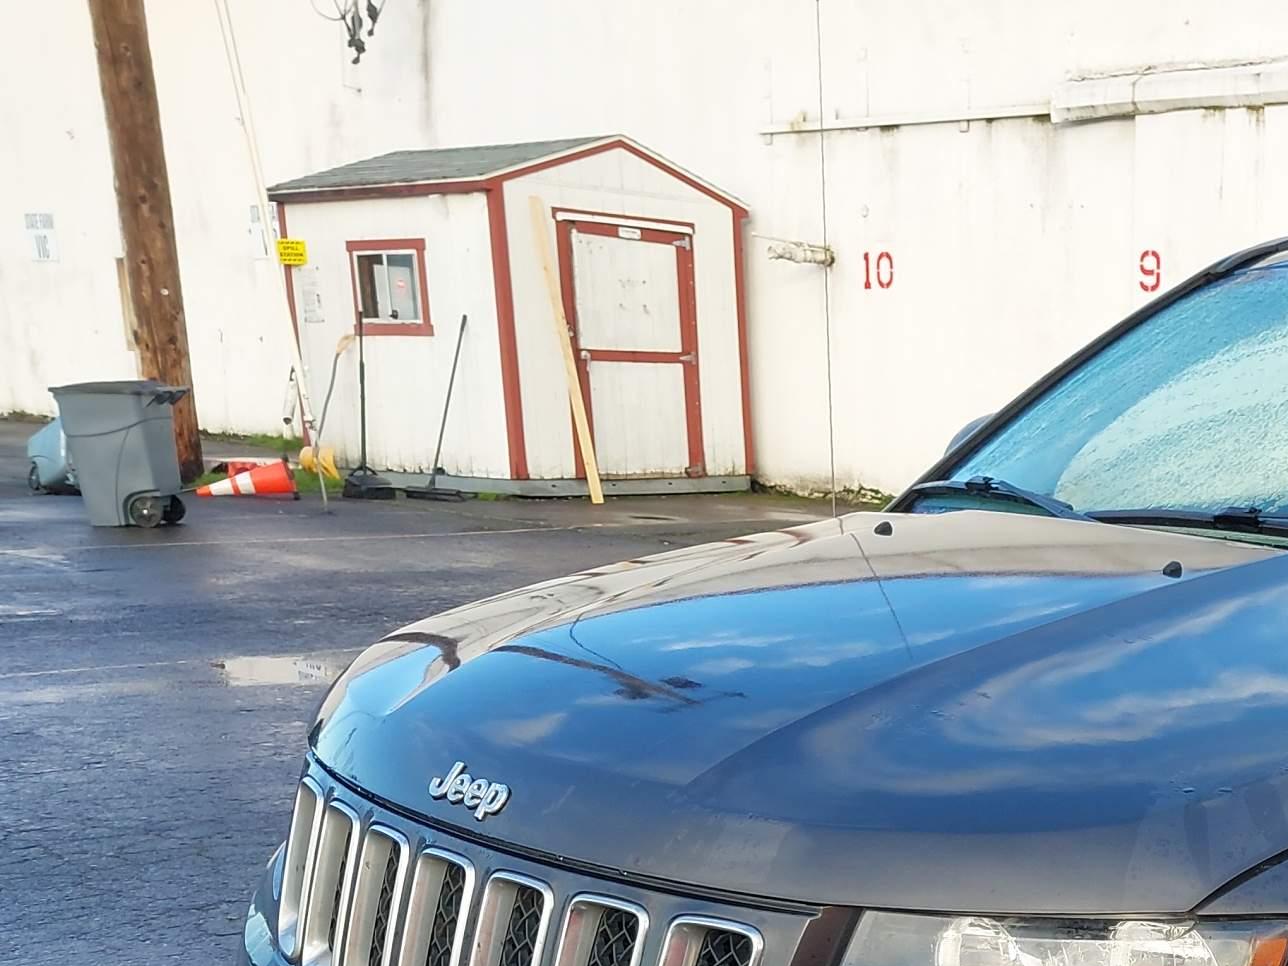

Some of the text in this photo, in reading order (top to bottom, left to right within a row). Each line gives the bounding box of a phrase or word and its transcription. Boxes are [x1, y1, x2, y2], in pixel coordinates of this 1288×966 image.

[863, 251, 894, 289] 10
[1139, 249, 1161, 292] 9
[428, 760, 512, 821] Jeep
